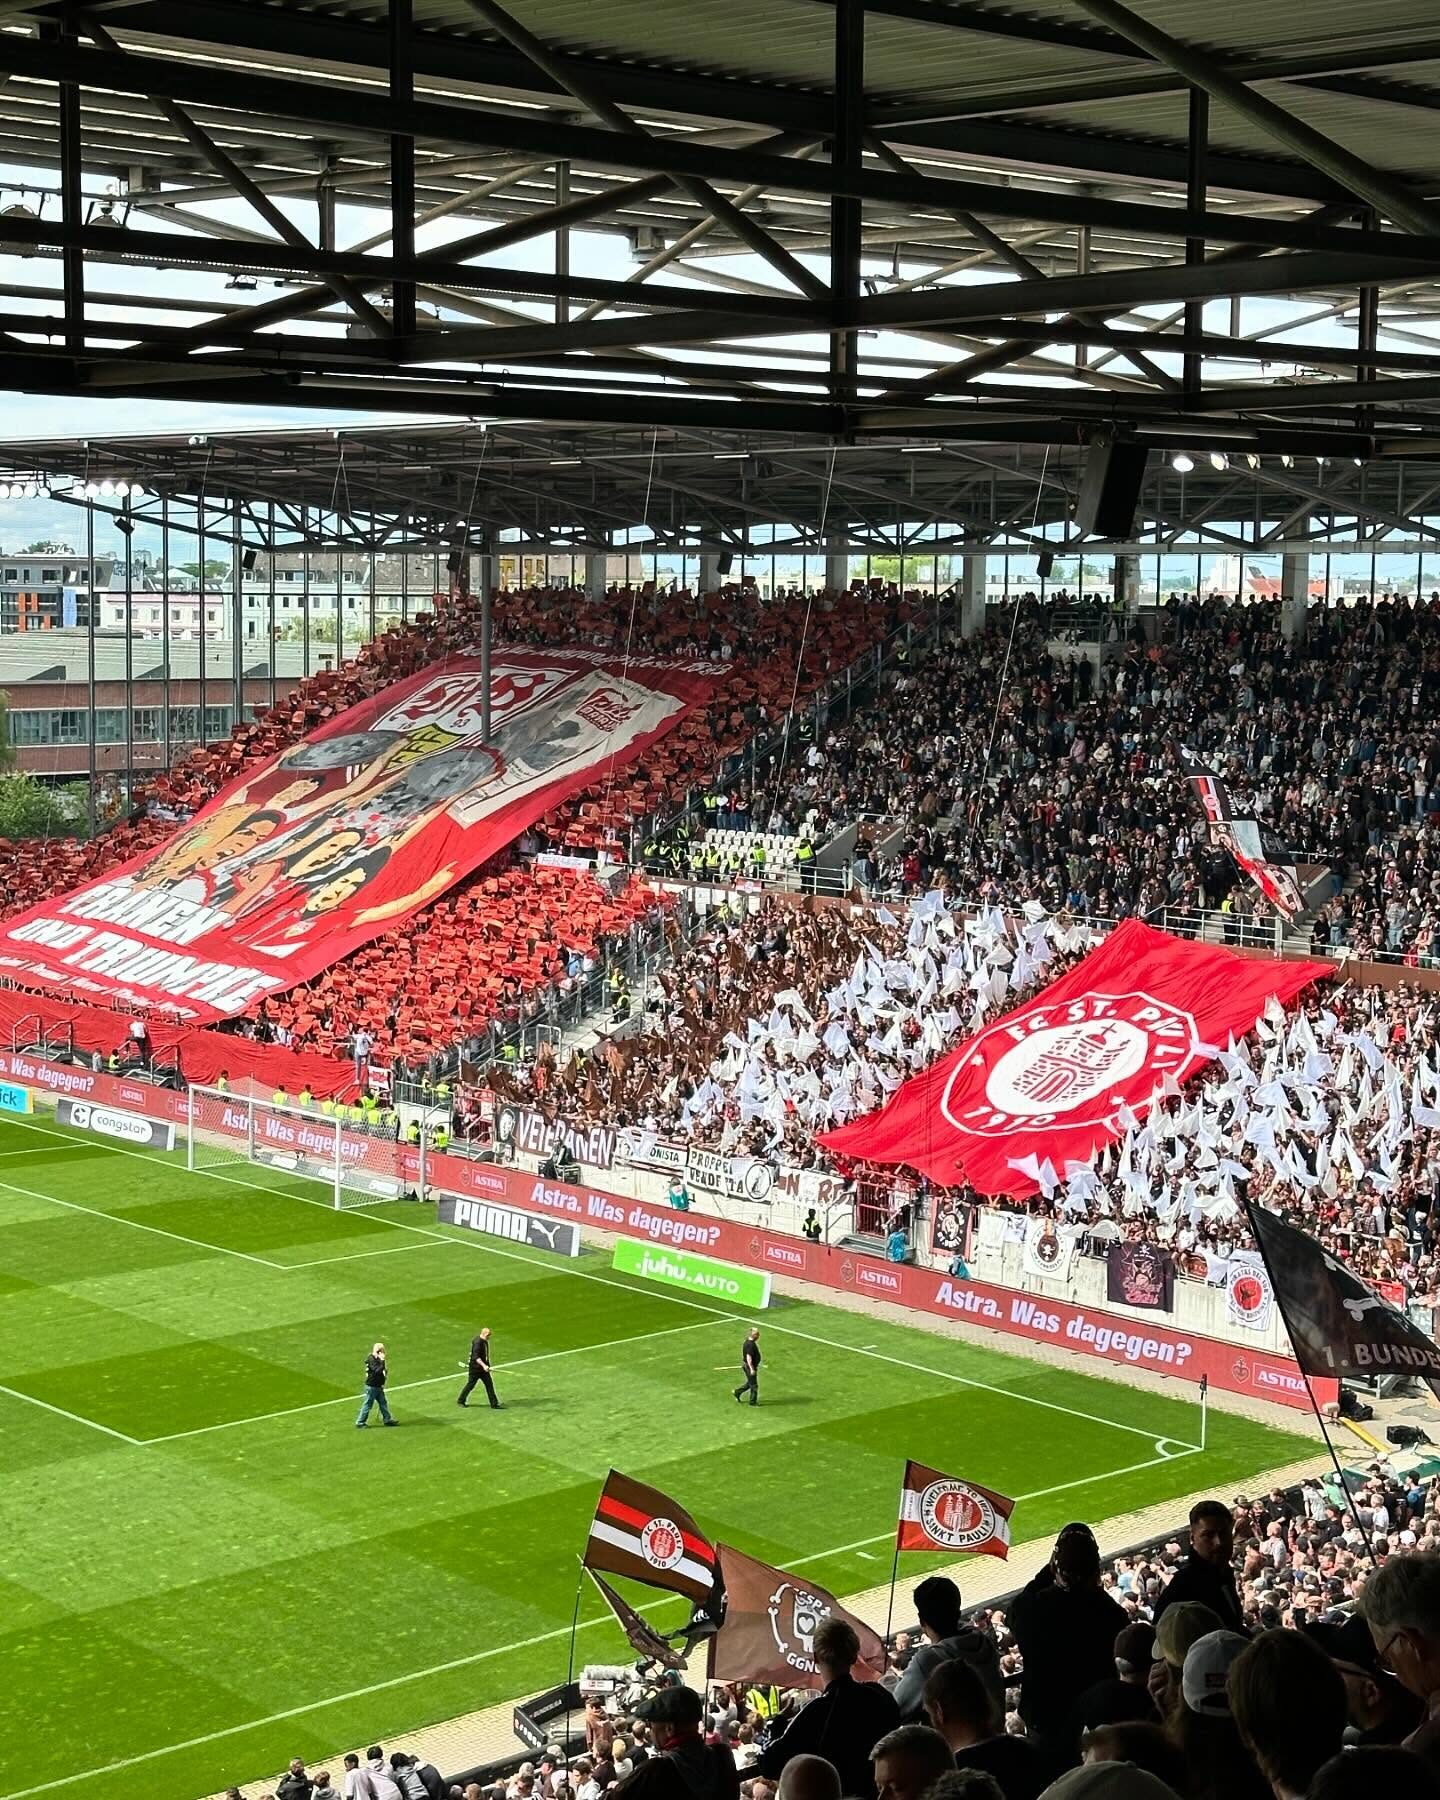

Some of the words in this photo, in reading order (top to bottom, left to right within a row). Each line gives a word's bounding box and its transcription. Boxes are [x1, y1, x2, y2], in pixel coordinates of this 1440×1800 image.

[7, 918, 96, 949] UND
[60, 931, 285, 1014] TRIUMPHE
[1005, 1015, 1049, 1041] FC
[1067, 1000, 1118, 1022] ST.
[11, 1057, 35, 1078] Was
[36, 1064, 95, 1093] dagegen?
[121, 1089, 144, 1101] ASTRA
[97, 1114, 146, 1135] congstar
[963, 1106, 1056, 1131] 1910
[265, 1118, 295, 1141] Was
[475, 1174, 503, 1190] ASTRA
[531, 1183, 582, 1212] Astra.
[587, 1195, 625, 1224] Was
[629, 1206, 721, 1246] dagegen?
[766, 1246, 801, 1264] ASTRA
[860, 1270, 898, 1288] ASTRA
[935, 1281, 1003, 1318] Astra.
[1010, 1299, 1060, 1334] Was
[1066, 1315, 1192, 1366] dagegen?
[1322, 1346, 1349, 1367] 1.
[1258, 1371, 1307, 1393] ASTRA
[966, 1487, 978, 1498] TO
[666, 1522, 682, 1550] PAULI
[959, 1526, 989, 1543] PAULI
[649, 1555, 667, 1567] 1910
